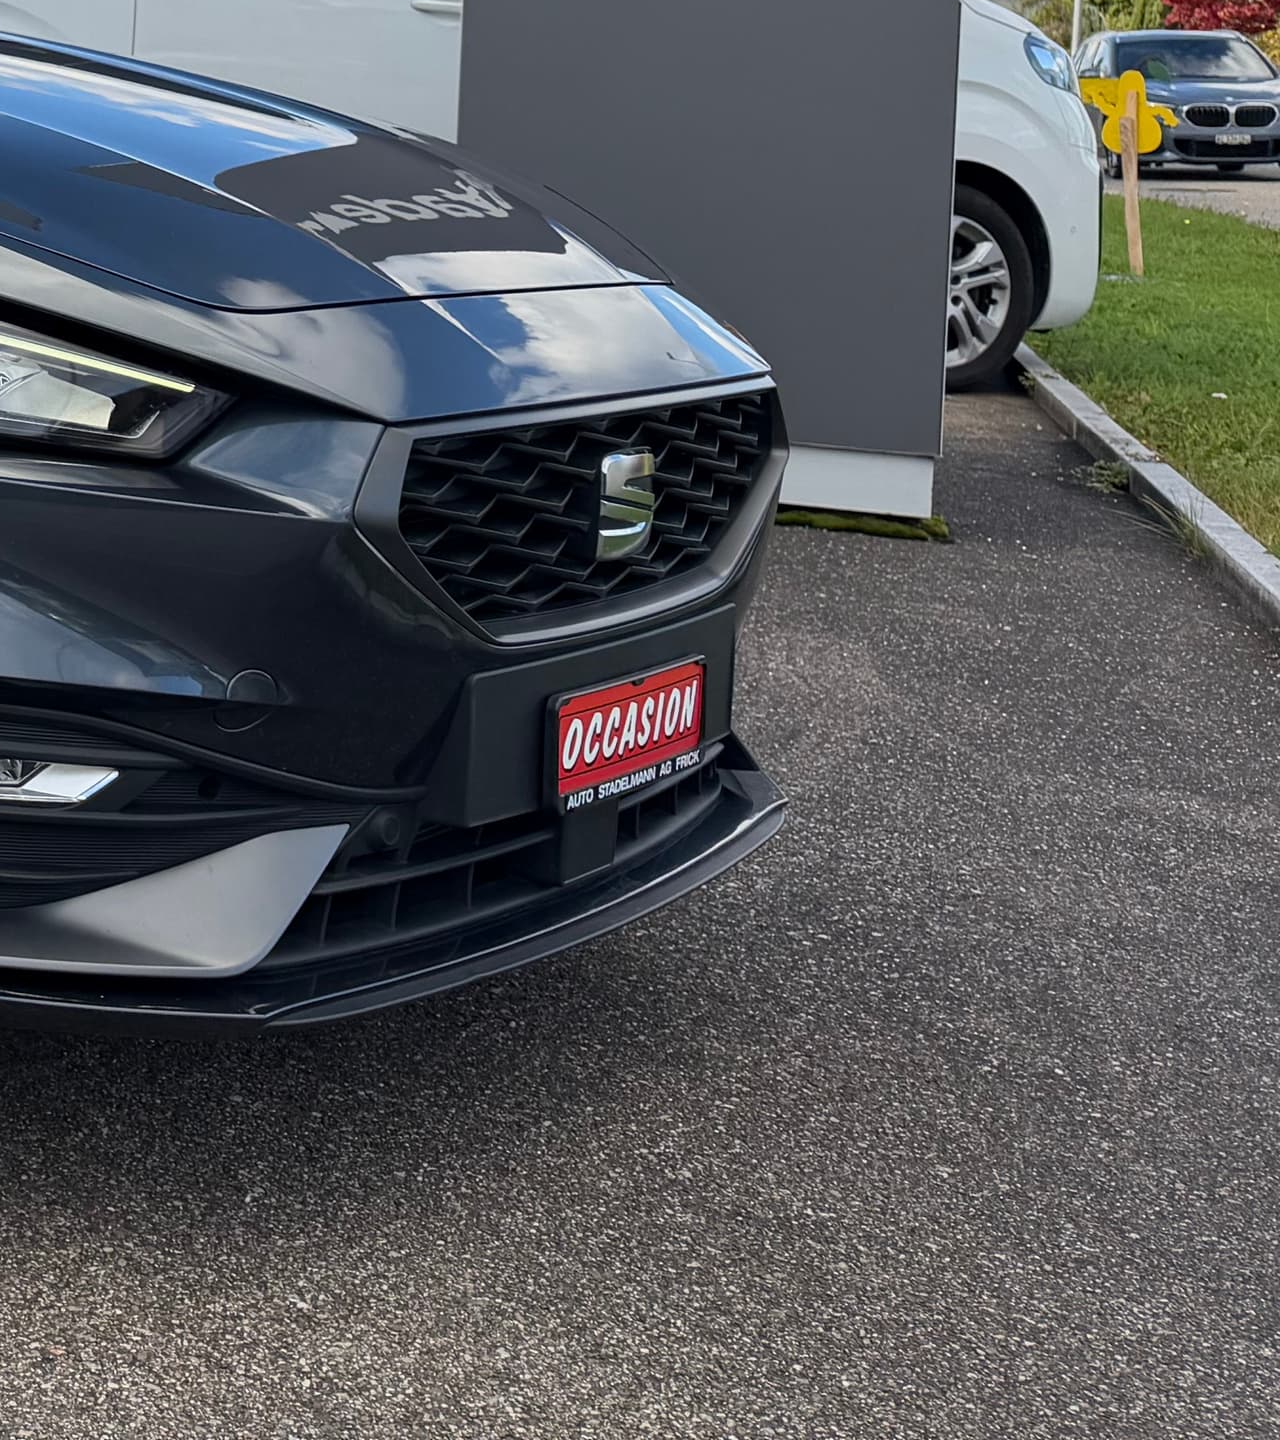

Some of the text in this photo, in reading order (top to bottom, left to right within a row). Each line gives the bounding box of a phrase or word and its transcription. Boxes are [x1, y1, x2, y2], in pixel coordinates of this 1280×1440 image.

[561, 679, 698, 770] OCCASION
[567, 750, 700, 810] AUTO STADELMANN AG FRICK
